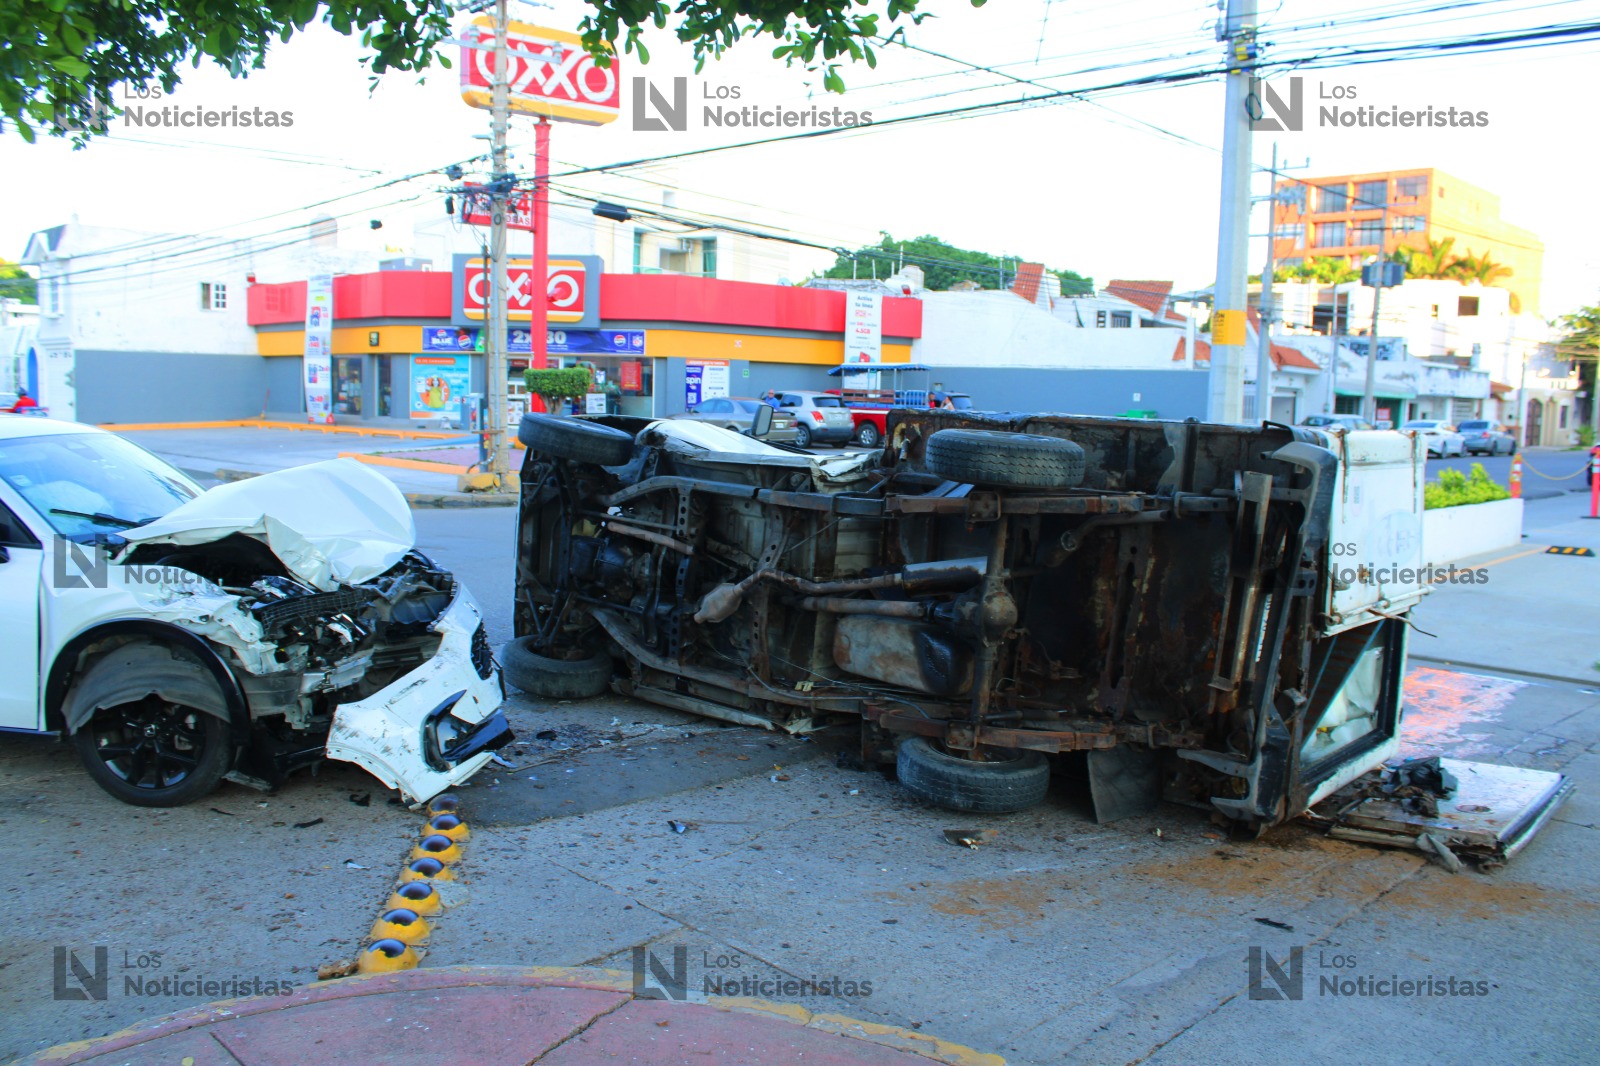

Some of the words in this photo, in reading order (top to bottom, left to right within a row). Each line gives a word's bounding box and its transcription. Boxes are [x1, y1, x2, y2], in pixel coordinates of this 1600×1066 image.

[475, 38, 615, 102] OXXO
[468, 272, 580, 308] OXO
[512, 330, 566, 344] 2x30
